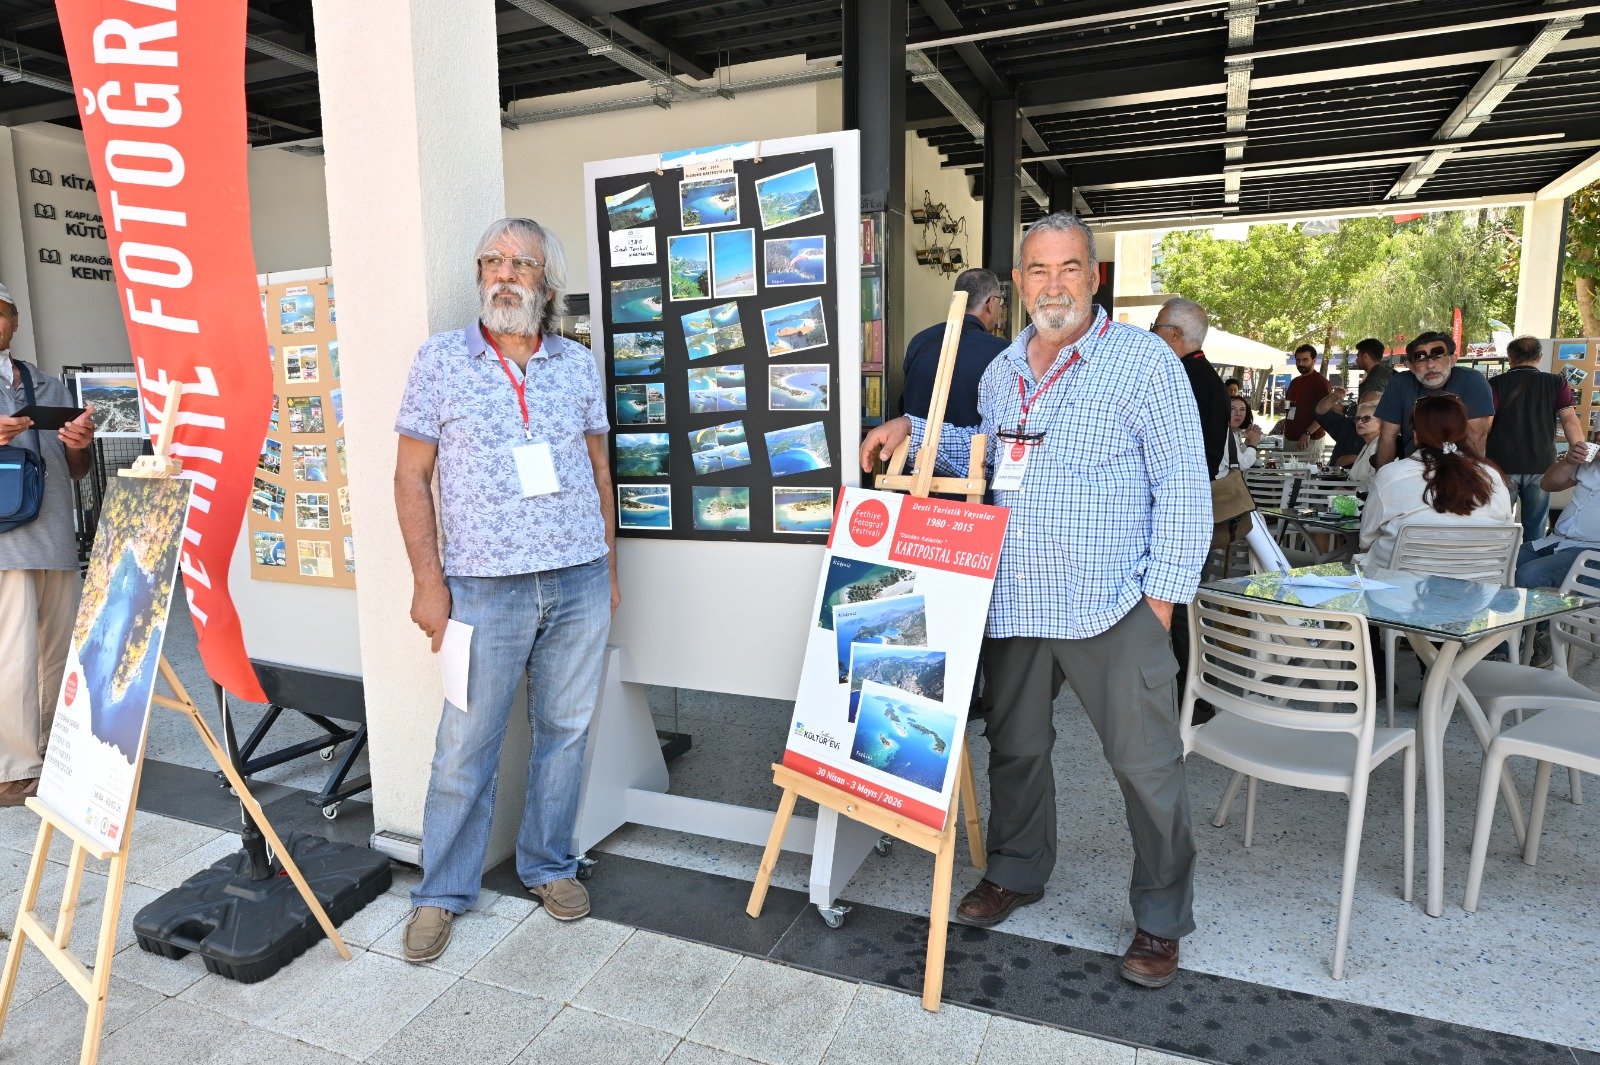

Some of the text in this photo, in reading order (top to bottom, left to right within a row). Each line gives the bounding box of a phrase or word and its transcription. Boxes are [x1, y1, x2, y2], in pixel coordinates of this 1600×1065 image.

[82, 0, 201, 334] FOTOĞR
[71, 266, 112, 282] KENT
[856, 510, 882, 520] Fethiye
[912, 503, 932, 512] Desti
[933, 505, 961, 516] Turistik
[926, 518, 946, 529] 1980
[952, 522, 974, 533] 2015
[895, 541, 994, 571] KARTPOSTAL SERGİSİ
[816, 767, 825, 777] 30
[826, 771, 845, 785] Nisan
[850, 781, 856, 789] 3
[857, 783, 878, 798] Mayıs
[883, 794, 903, 808] 2026
